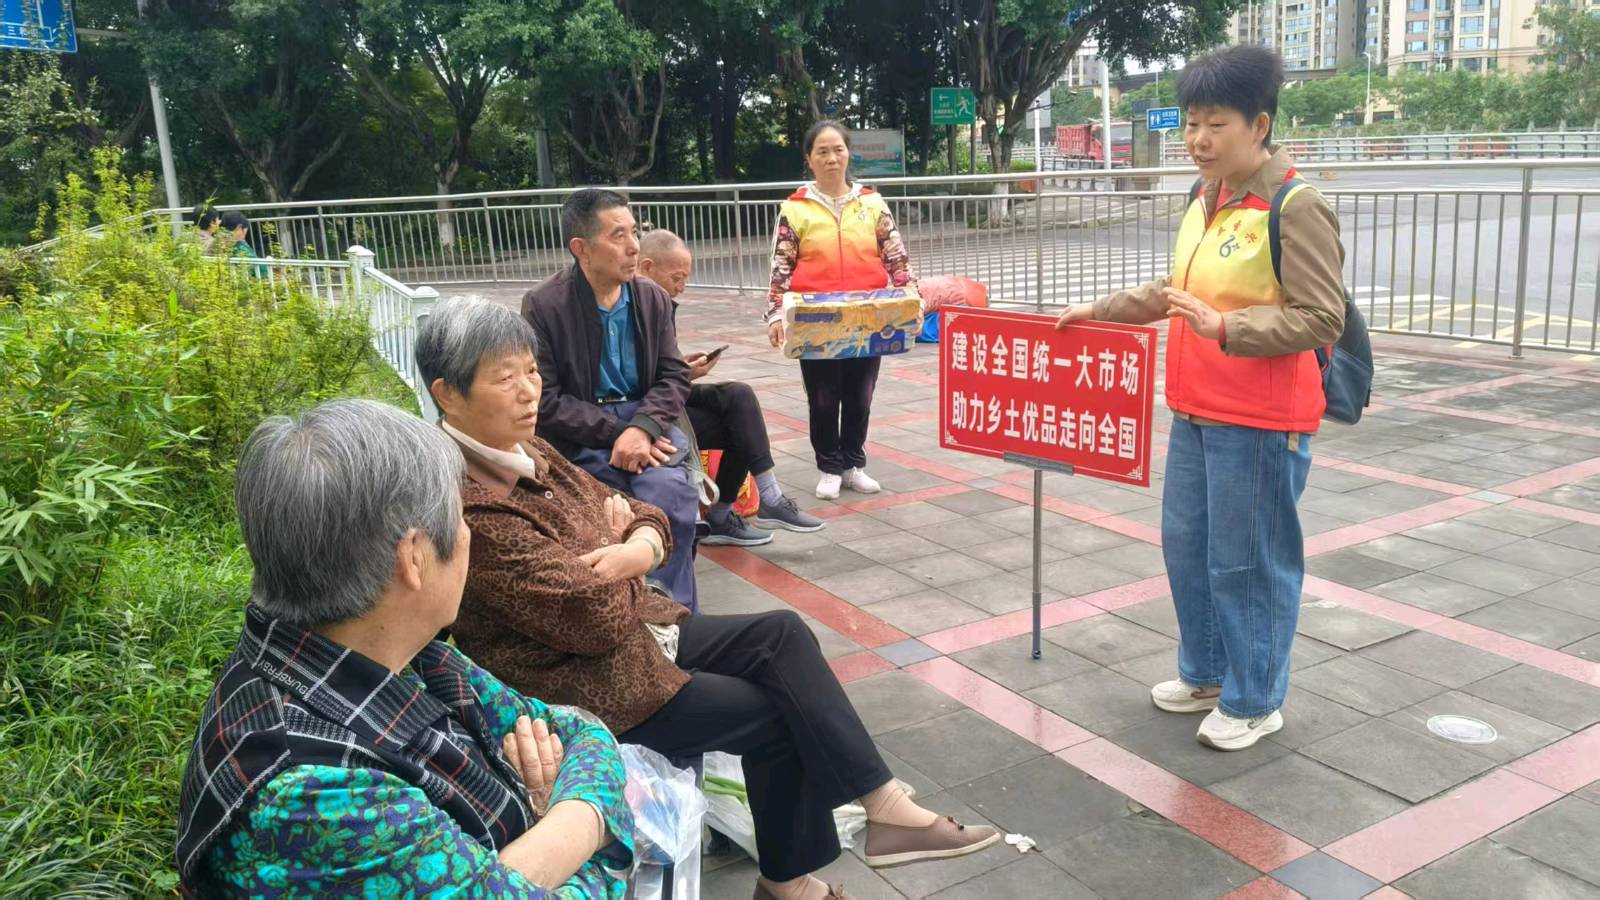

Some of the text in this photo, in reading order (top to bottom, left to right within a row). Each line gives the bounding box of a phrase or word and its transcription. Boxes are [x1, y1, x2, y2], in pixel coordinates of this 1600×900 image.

[952, 332, 1139, 395] 建设全国统一大市场
[952, 391, 1137, 460] 助力乡土优品走向全国
